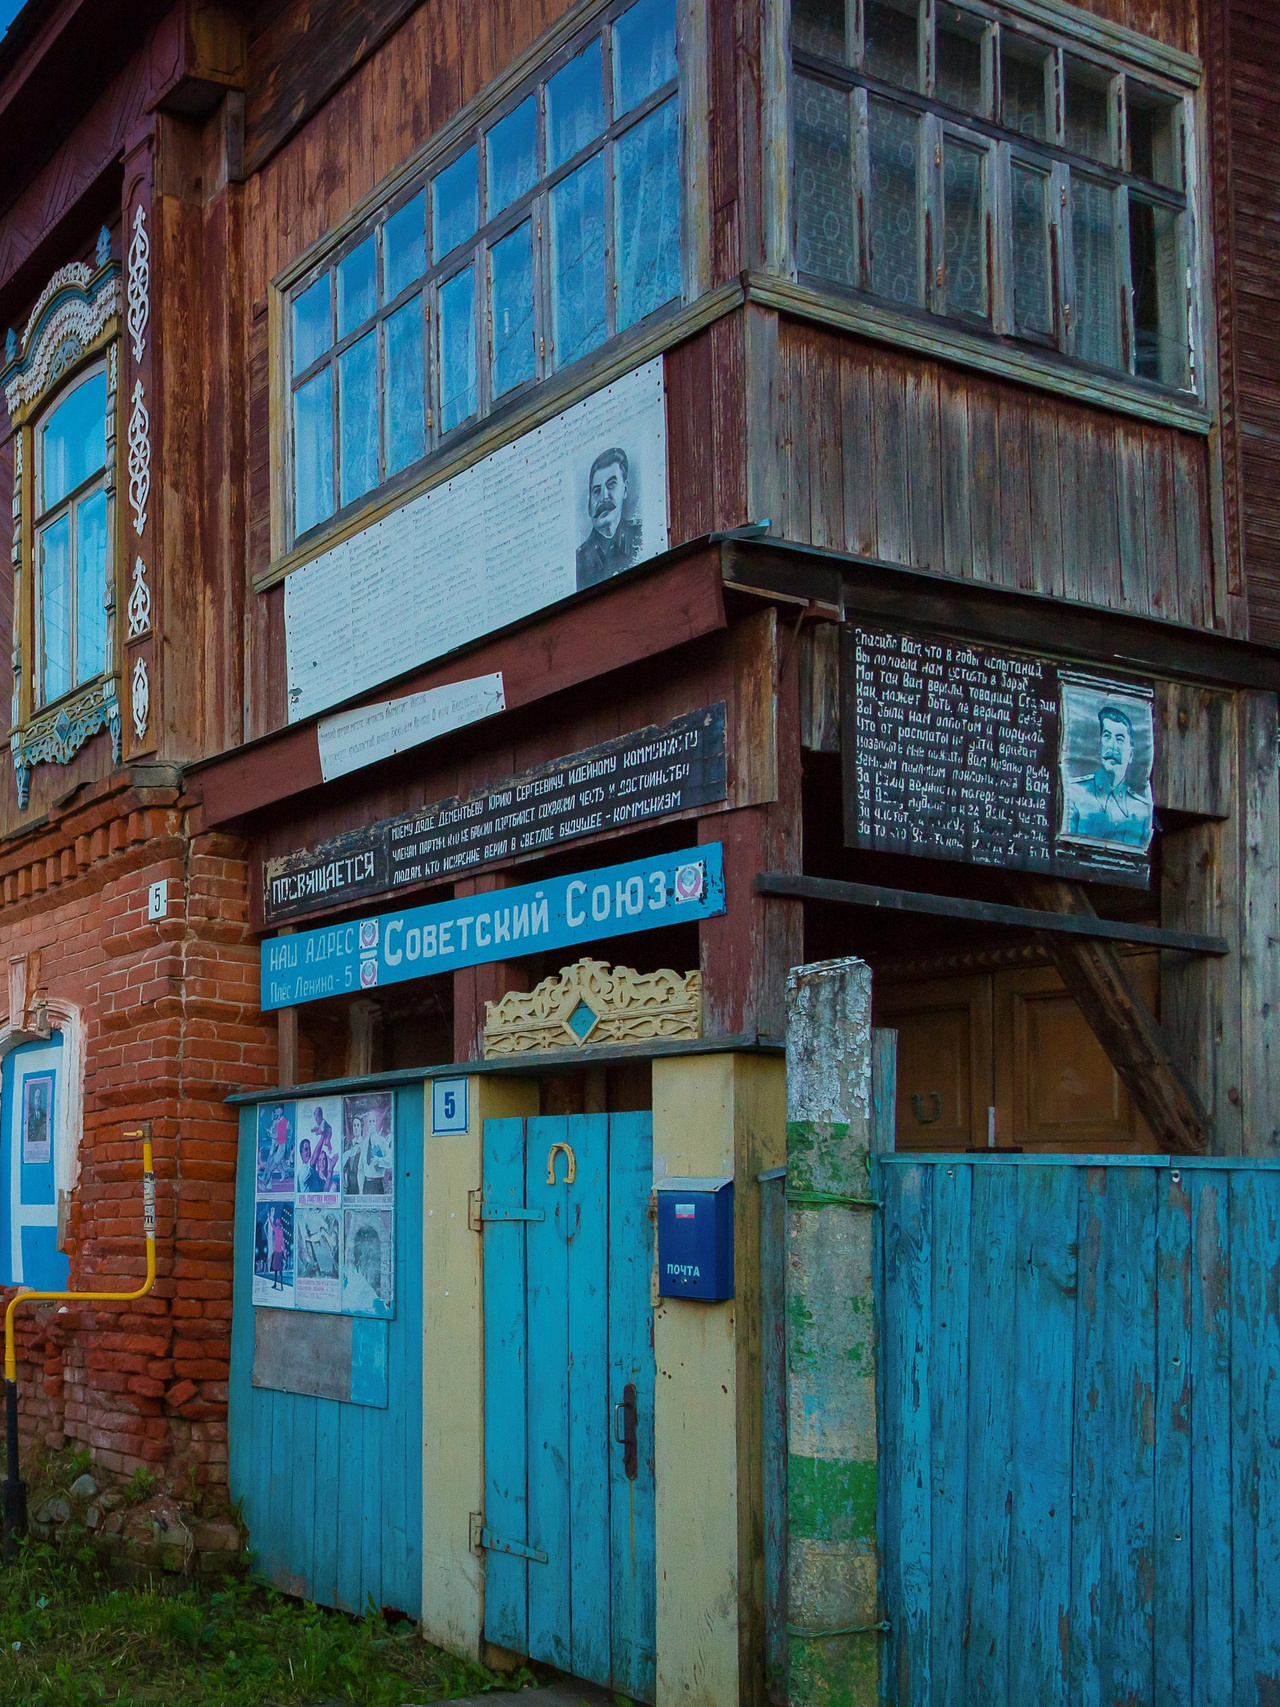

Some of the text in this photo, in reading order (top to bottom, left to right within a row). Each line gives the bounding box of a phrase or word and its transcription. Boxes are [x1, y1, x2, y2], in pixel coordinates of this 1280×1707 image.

[855, 646, 870, 664] Вы
[922, 662, 943, 677] нам
[990, 674, 997, 686] в
[925, 646, 942, 659] что
[946, 649, 952, 661] в
[955, 649, 979, 667] годы
[855, 664, 874, 681] Мы
[880, 670, 898, 686] так
[903, 672, 923, 690] Вам
[882, 690, 921, 706] может
[856, 698, 872, 716] Вы
[909, 710, 932, 725] нам
[986, 723, 993, 736] и
[856, 715, 876, 732] Что
[881, 723, 893, 735] от
[898, 726, 949, 745] расплаты
[391, 824, 414, 841] МОЕМУ
[438, 800, 484, 827] ДЕМЕНТЬЕВУ
[488, 791, 512, 812] ЮРИЮ
[568, 756, 617, 786] ИДЕЙНОМУ
[623, 730, 698, 769] КОММУНИСТУ
[857, 766, 870, 784] За
[1026, 764, 1050, 782] руку
[858, 783, 871, 801] За
[392, 845, 418, 862] ЧЛЕНАМ
[448, 833, 460, 847] КТО
[460, 829, 469, 843] НЕ
[470, 821, 493, 840] БРОСИЛ
[579, 787, 605, 807] ЧЕСТЬ
[425, 860, 440, 876] КТО
[484, 839, 508, 859] ВЕРИЛ
[511, 837, 517, 851] В
[520, 826, 555, 848] СВЕТЛОЕ
[613, 790, 682, 823] КОММУНИЗМ
[874, 823, 886, 837] то
[272, 851, 375, 905] ПОСВЯЩАЕТСЯ
[154, 887, 161, 912] 5
[270, 942, 298, 972] НАШ
[305, 927, 354, 964] АДРЕС
[270, 981, 291, 1004] Плёс
[294, 974, 334, 999] Ленина
[344, 965, 353, 988] 5
[444, 1091, 456, 1119] 5
[666, 1263, 700, 1277] ПОЧТА
